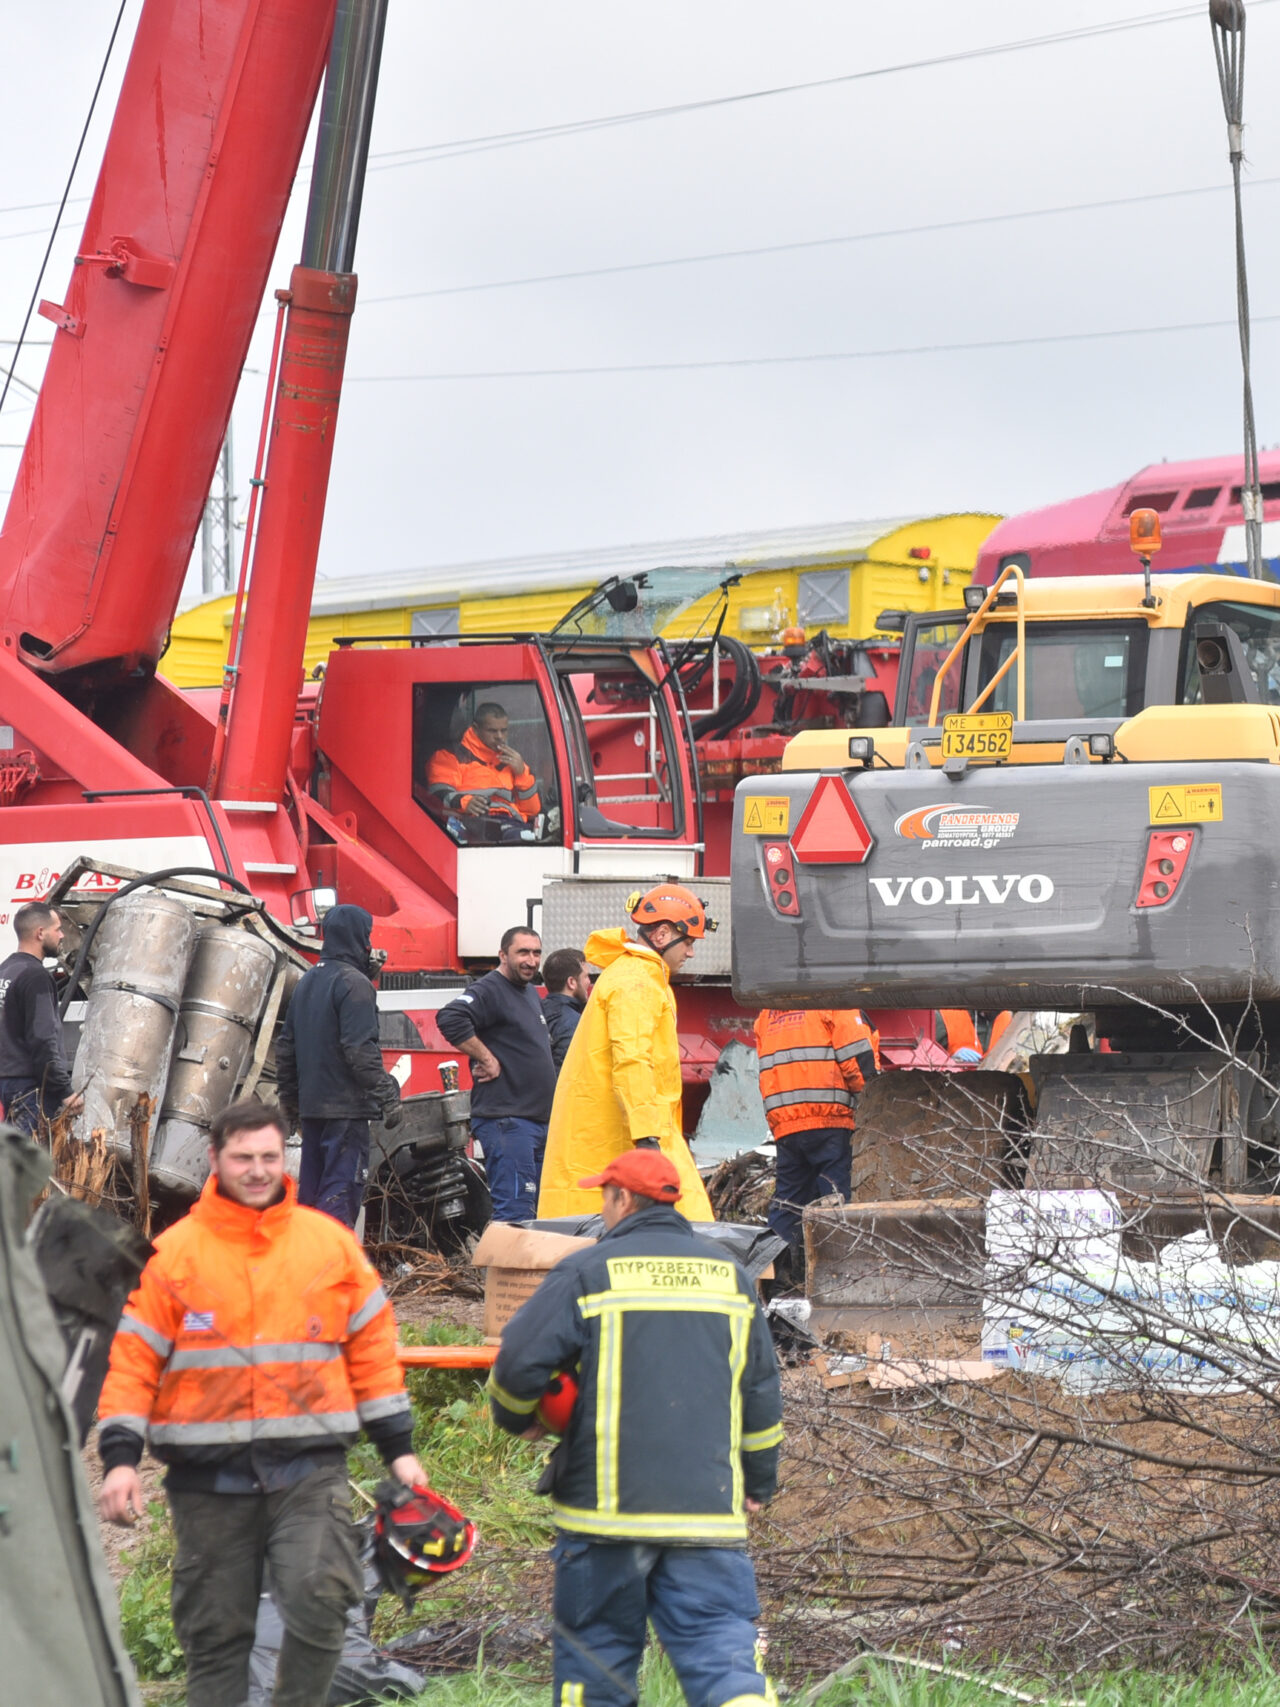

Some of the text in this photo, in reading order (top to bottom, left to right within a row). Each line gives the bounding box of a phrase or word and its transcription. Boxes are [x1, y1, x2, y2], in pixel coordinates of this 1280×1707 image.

[949, 718, 966, 729] ME
[947, 732, 1008, 754] 134562
[939, 813, 1020, 825] PANDREMENOS
[980, 825, 1016, 833] GROUP
[922, 838, 1000, 850] panroad.gr
[869, 874, 1055, 906] VOLVO
[612, 1261, 730, 1278] ΠΥΡΟΣΒΕΣΤΙΚΟ
[651, 1275, 702, 1287] ΣΩΜΑ
